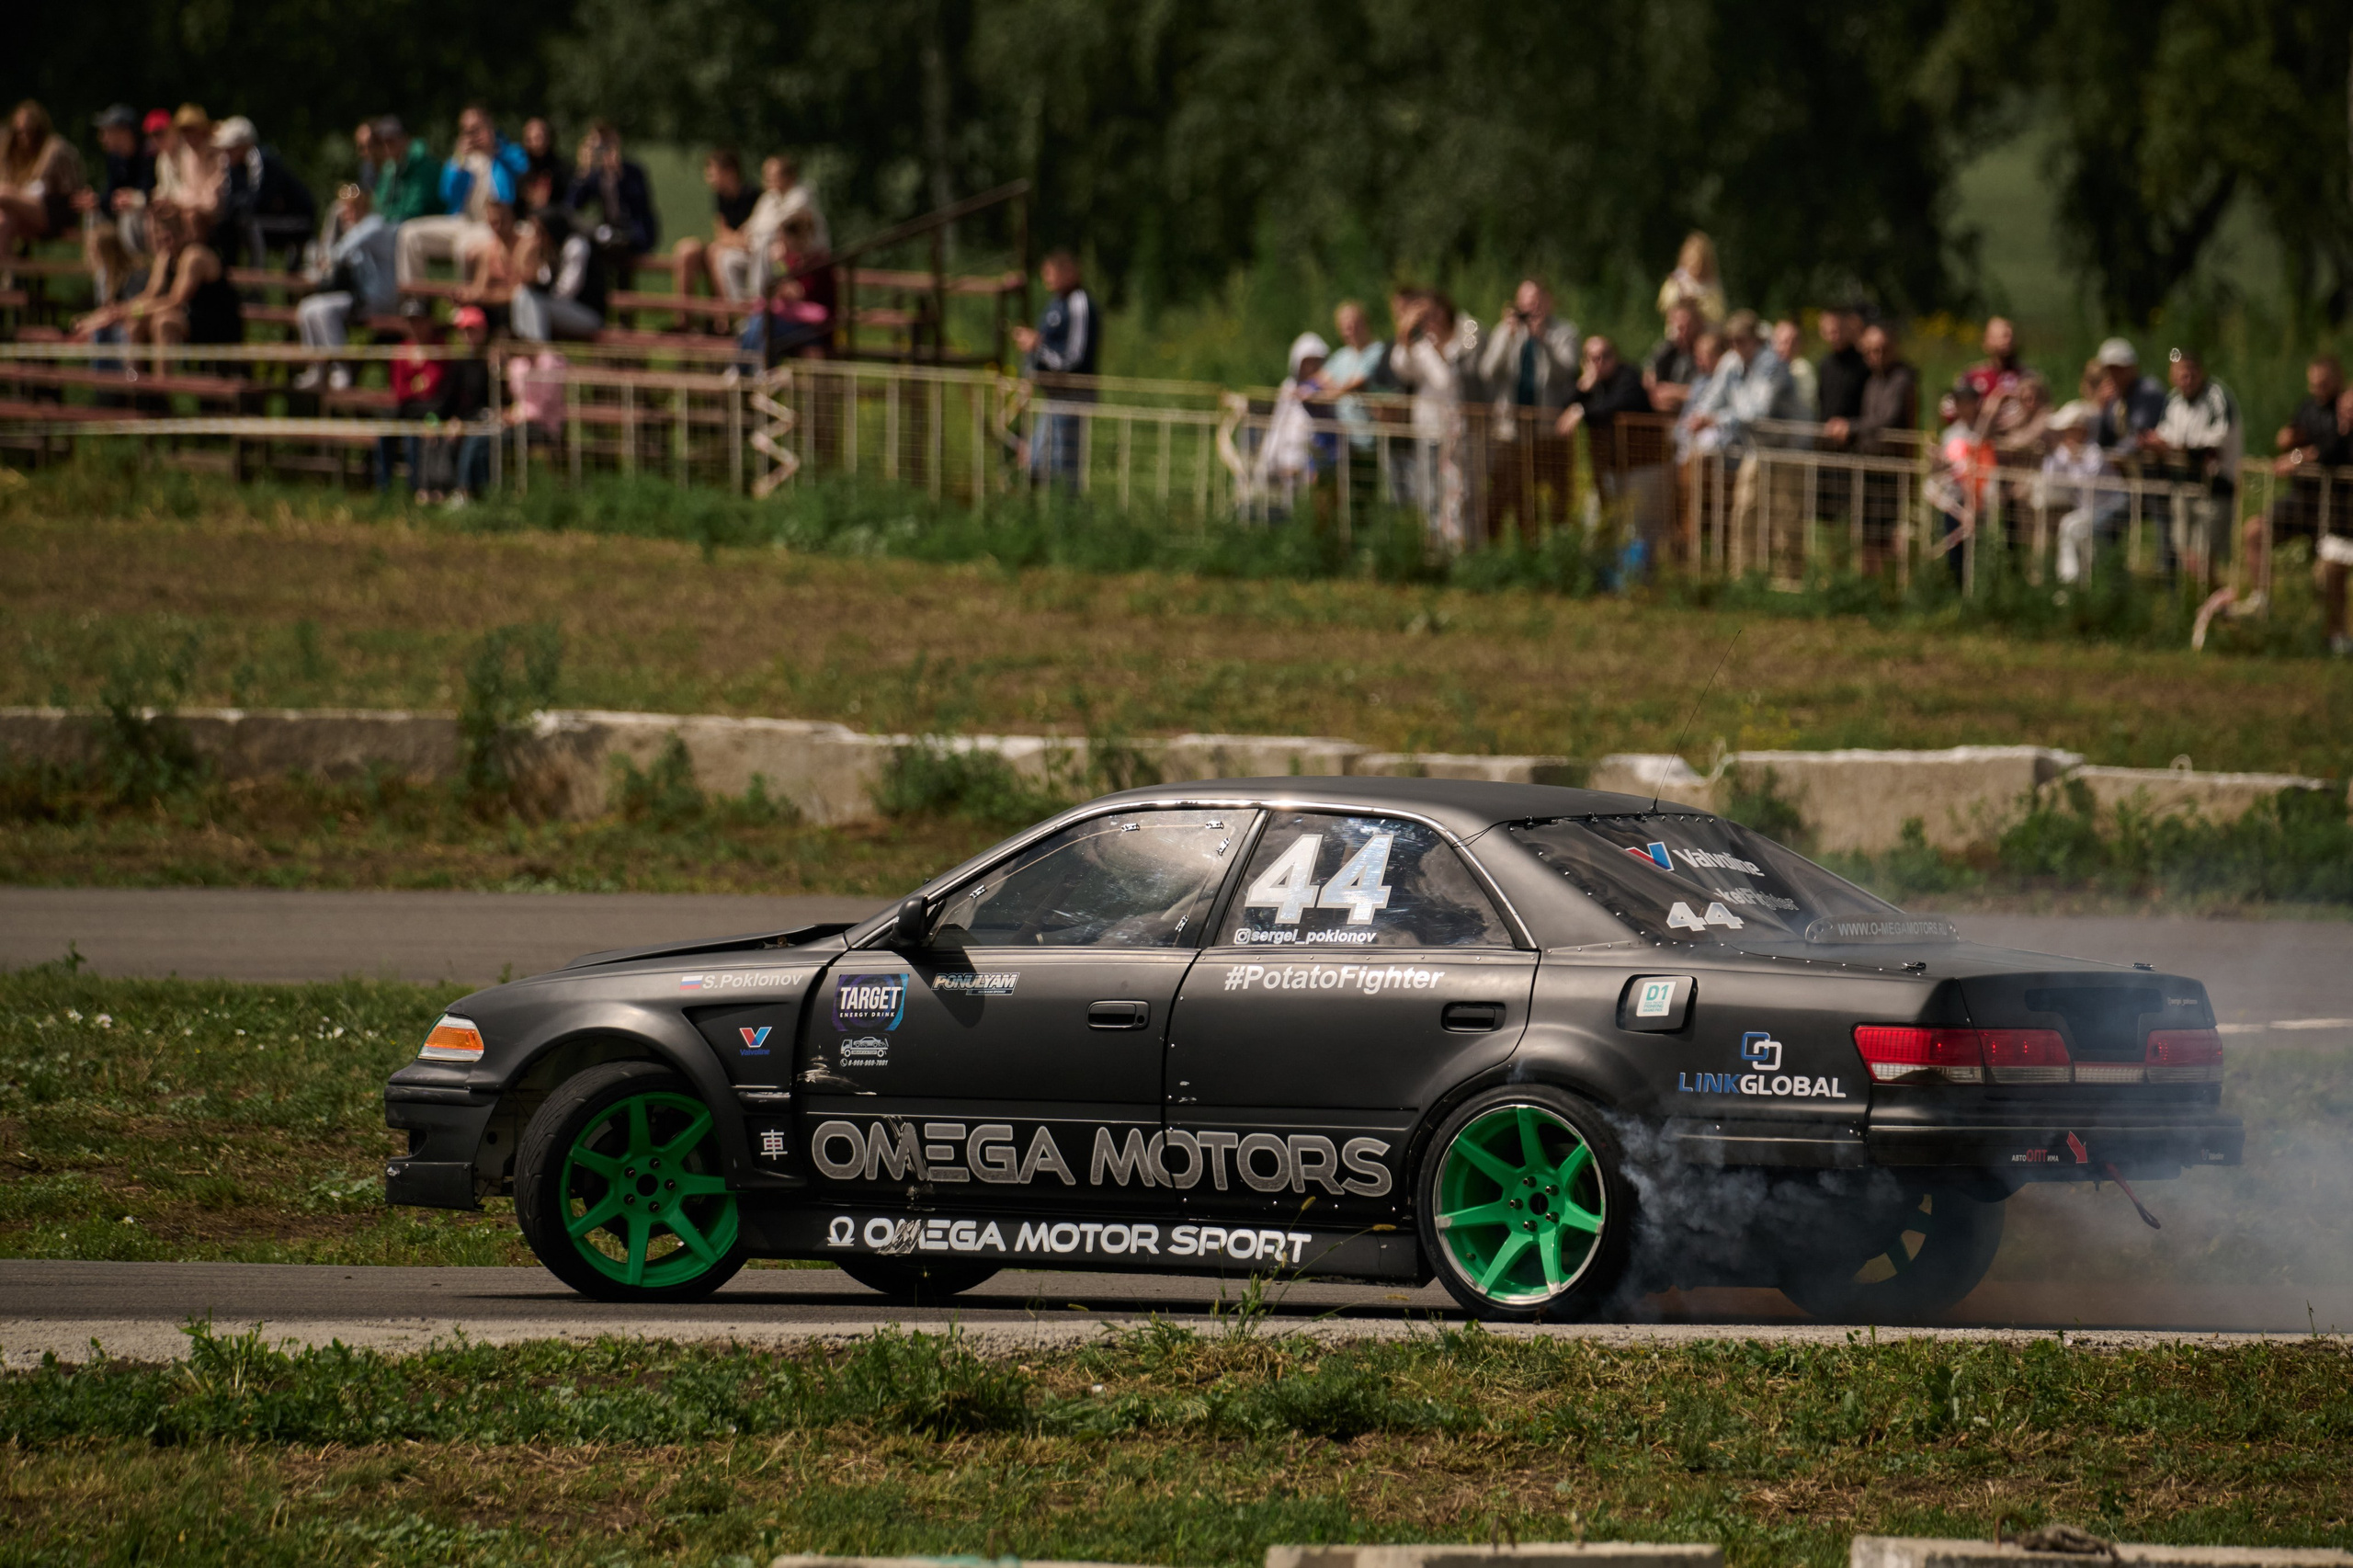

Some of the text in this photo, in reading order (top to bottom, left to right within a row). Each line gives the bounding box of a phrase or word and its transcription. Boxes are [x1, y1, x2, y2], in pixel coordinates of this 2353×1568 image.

[1672, 848, 1765, 876] Valvoline
[1245, 835, 1393, 925] 44
[1666, 902, 1745, 931] 44
[1838, 922, 1948, 936] WWW.O-MEGAMOTORS.RU
[702, 973, 802, 989] S.Poklonov
[933, 974, 1017, 989] PONULYAM
[1224, 965, 1445, 994] #PotatoFighter
[1646, 984, 1669, 1001] D1
[840, 986, 902, 1009] TARGET
[1678, 1072, 1847, 1097] LINKGLOBAL
[760, 1129, 789, 1160] 車
[812, 1120, 1392, 1197] OMEGA MOTORS
[1015, 1221, 1160, 1255] MOTOR
[1167, 1224, 1313, 1264] SPORT
